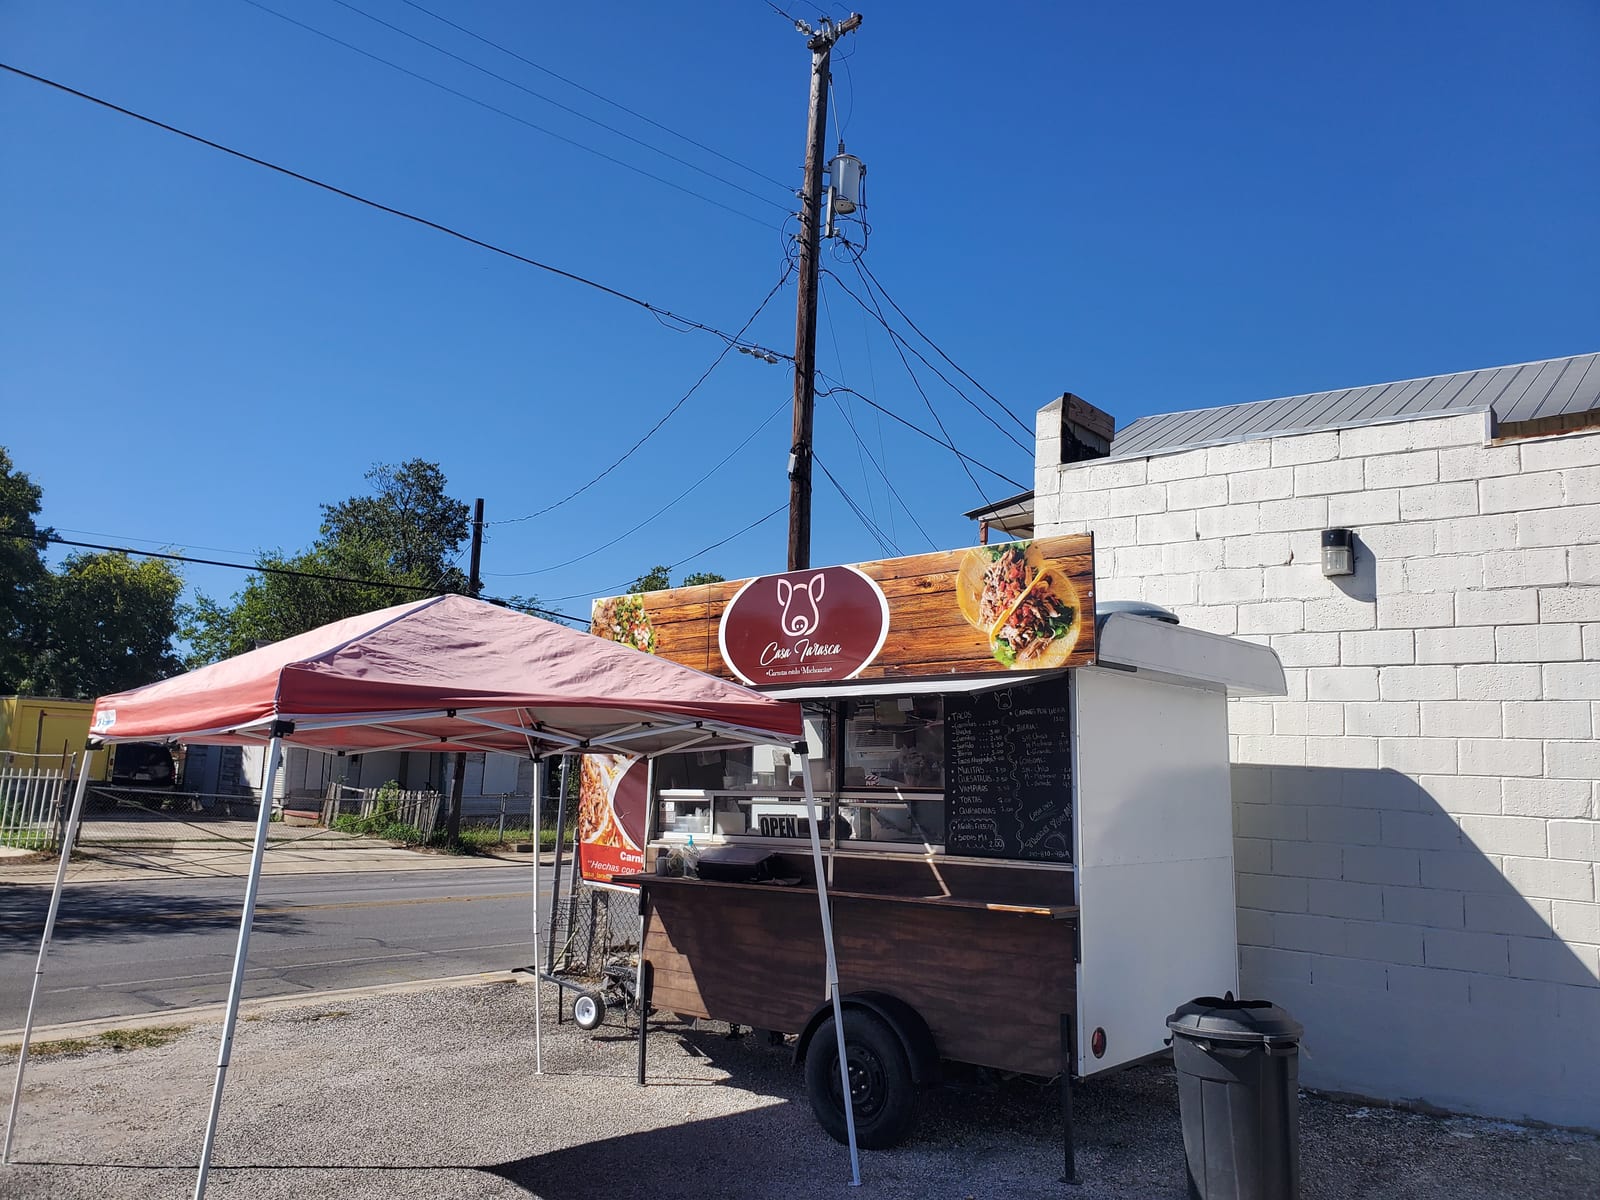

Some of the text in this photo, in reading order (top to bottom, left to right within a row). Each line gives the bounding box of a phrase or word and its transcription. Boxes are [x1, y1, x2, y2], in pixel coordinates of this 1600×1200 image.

[760, 638, 842, 666] Casa Tarasca
[951, 711, 972, 721] TACOS
[760, 817, 796, 838] OPEN
